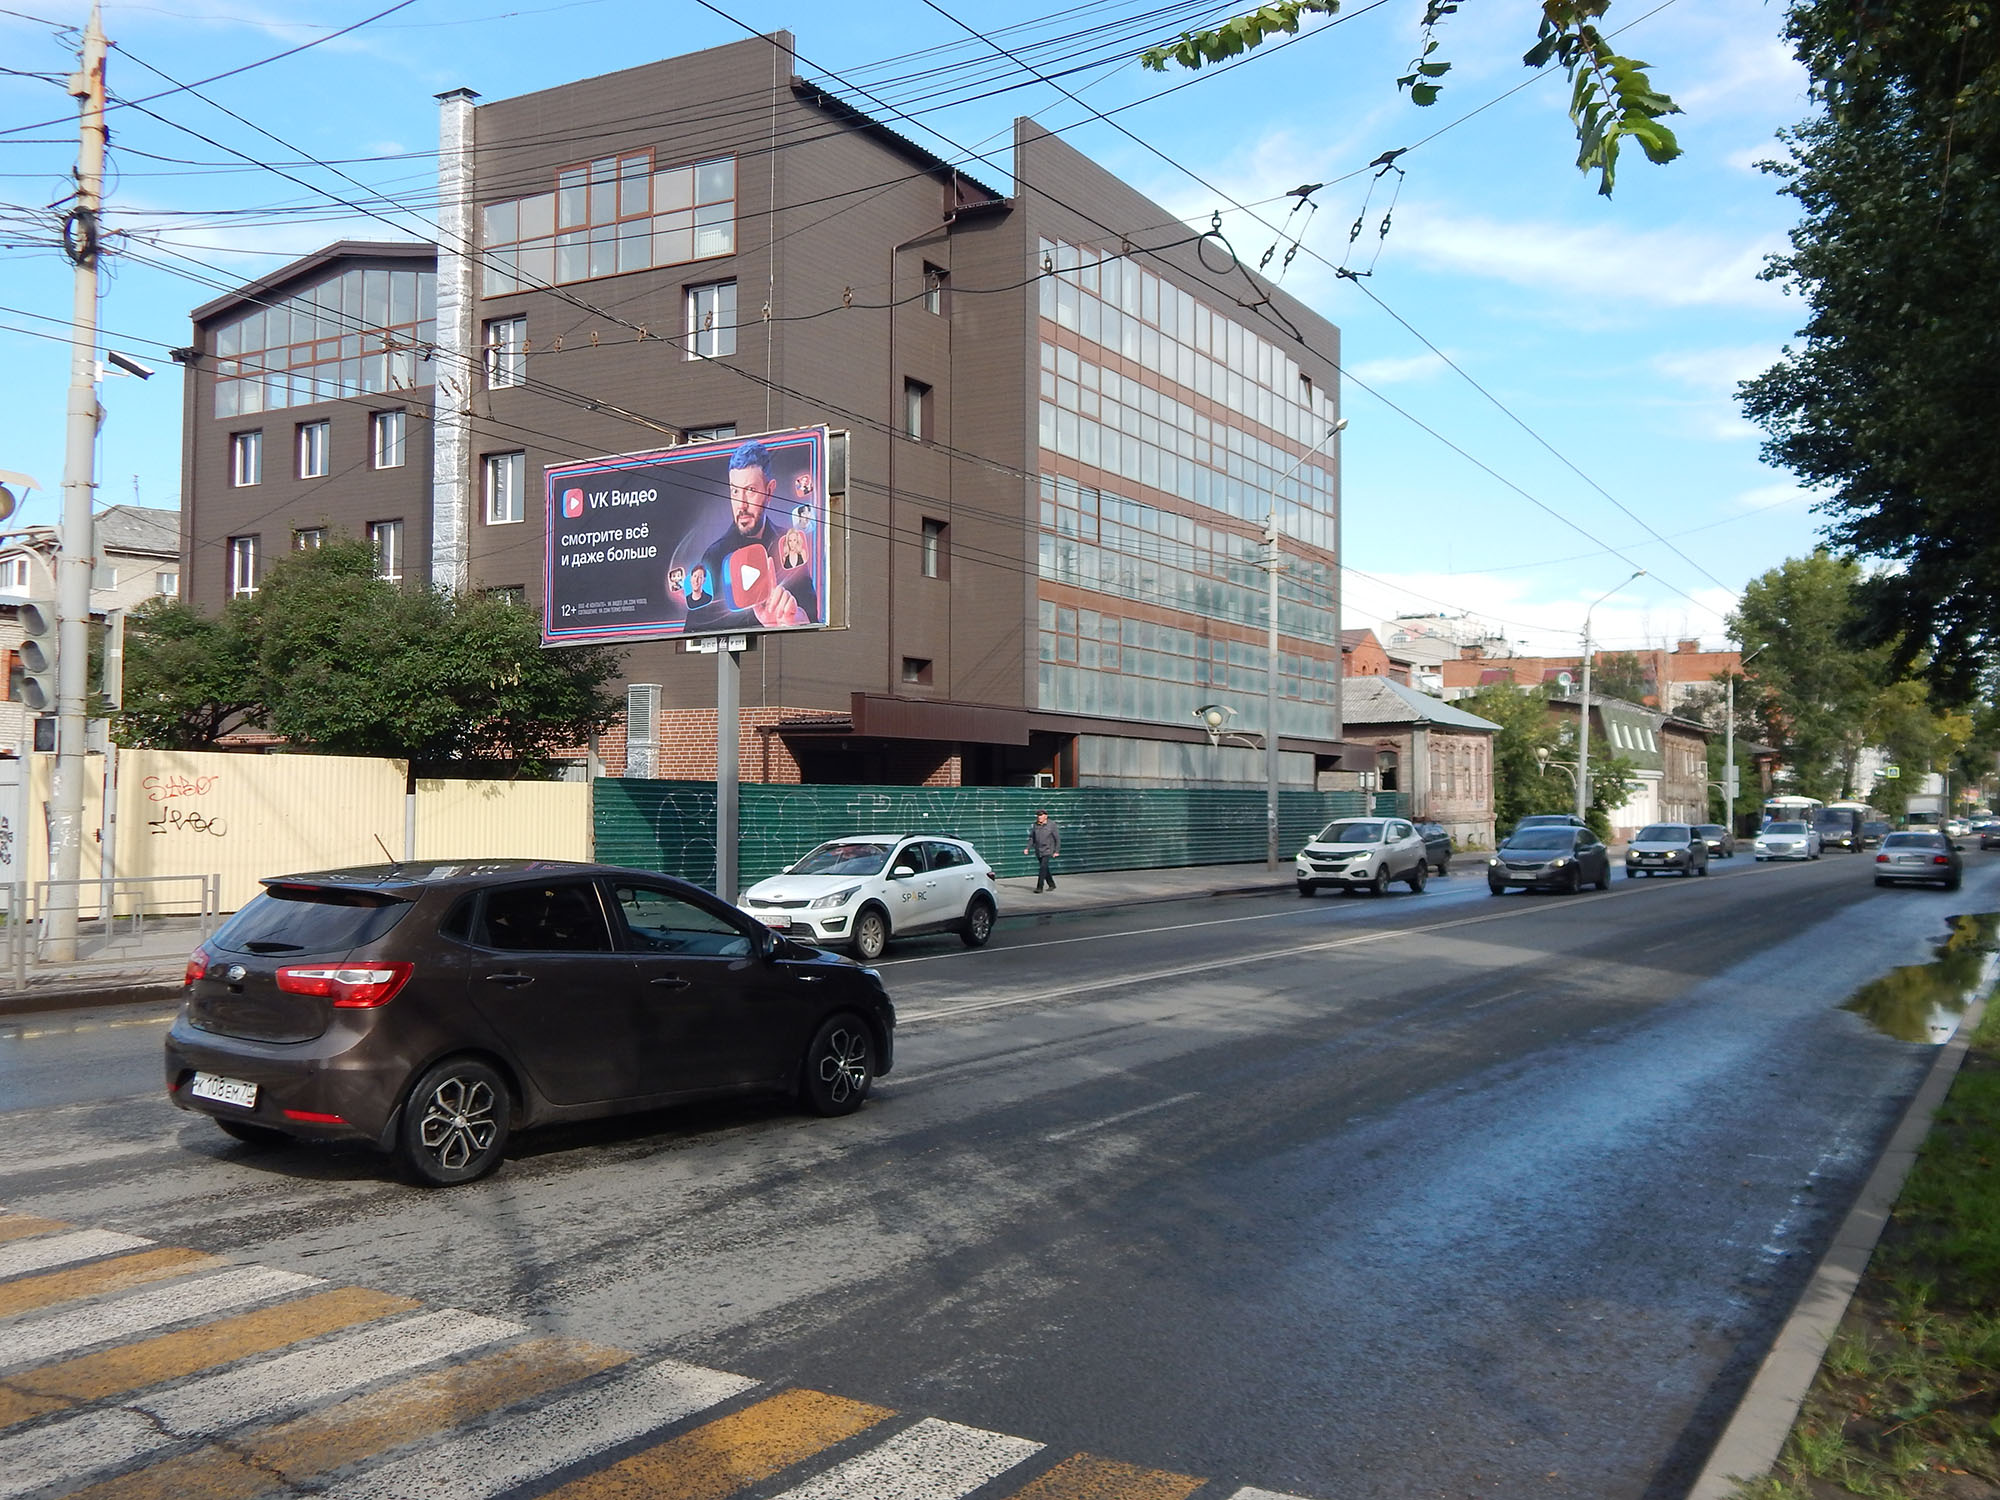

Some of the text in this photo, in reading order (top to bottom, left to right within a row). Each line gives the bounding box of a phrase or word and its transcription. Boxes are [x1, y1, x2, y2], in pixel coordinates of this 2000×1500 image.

[589, 489, 657, 509] VK Видео
[561, 522, 649, 547] смотрите всё
[561, 545, 657, 568] и даже больше
[561, 604, 577, 617] 12+
[902, 890, 928, 903] SPARC
